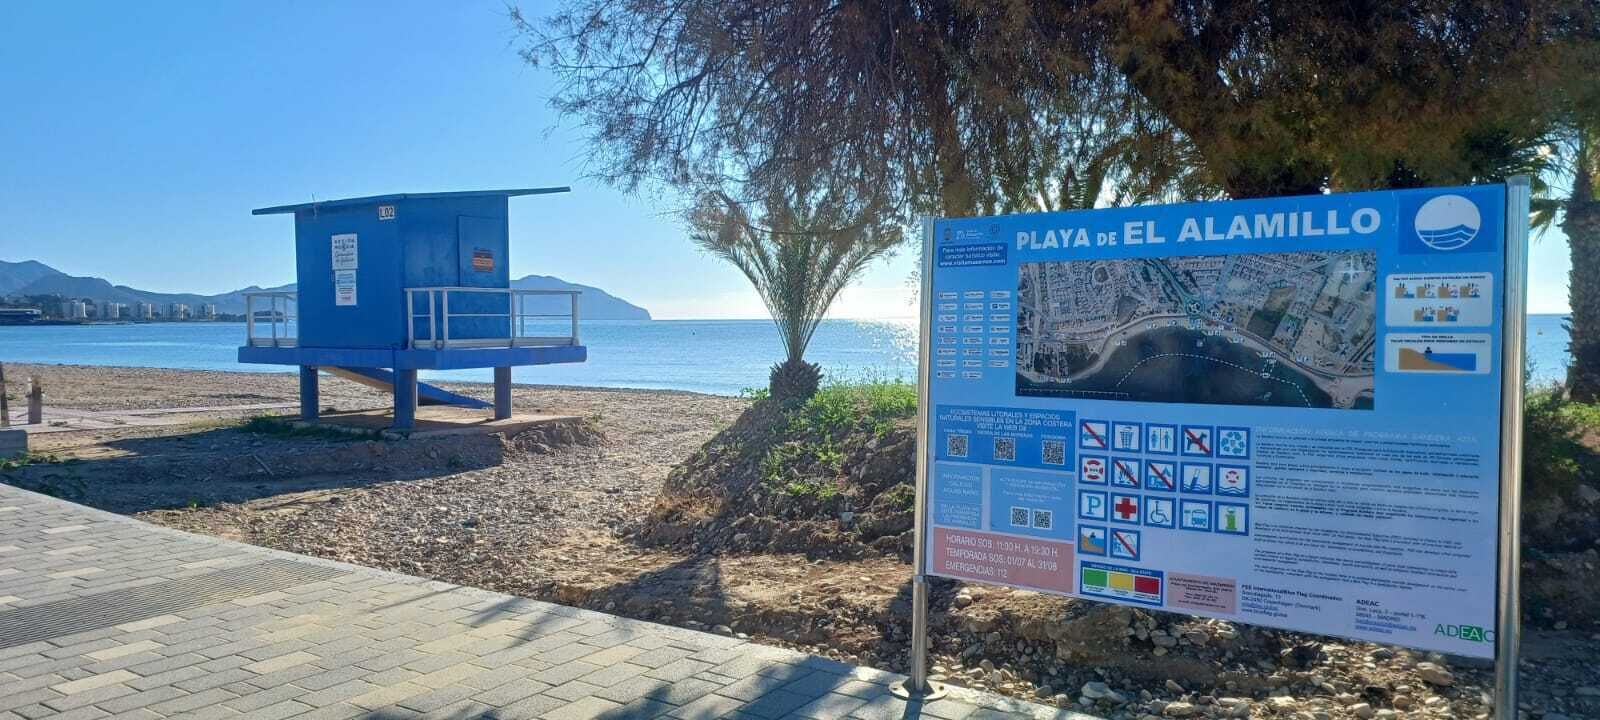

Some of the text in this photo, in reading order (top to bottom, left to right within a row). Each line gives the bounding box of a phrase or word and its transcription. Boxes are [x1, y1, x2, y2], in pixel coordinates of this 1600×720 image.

[1016, 207, 1381, 250] PLAYA DE EL ALAMILLO
[1043, 419, 1072, 428] COSTERA
[946, 534, 976, 546] HORARIO
[996, 541, 1014, 552] 11:00
[1024, 544, 1029, 553] A
[945, 548, 987, 560] TEMPORADA
[1007, 555, 1025, 566] 01/07
[1027, 559, 1036, 568] AL
